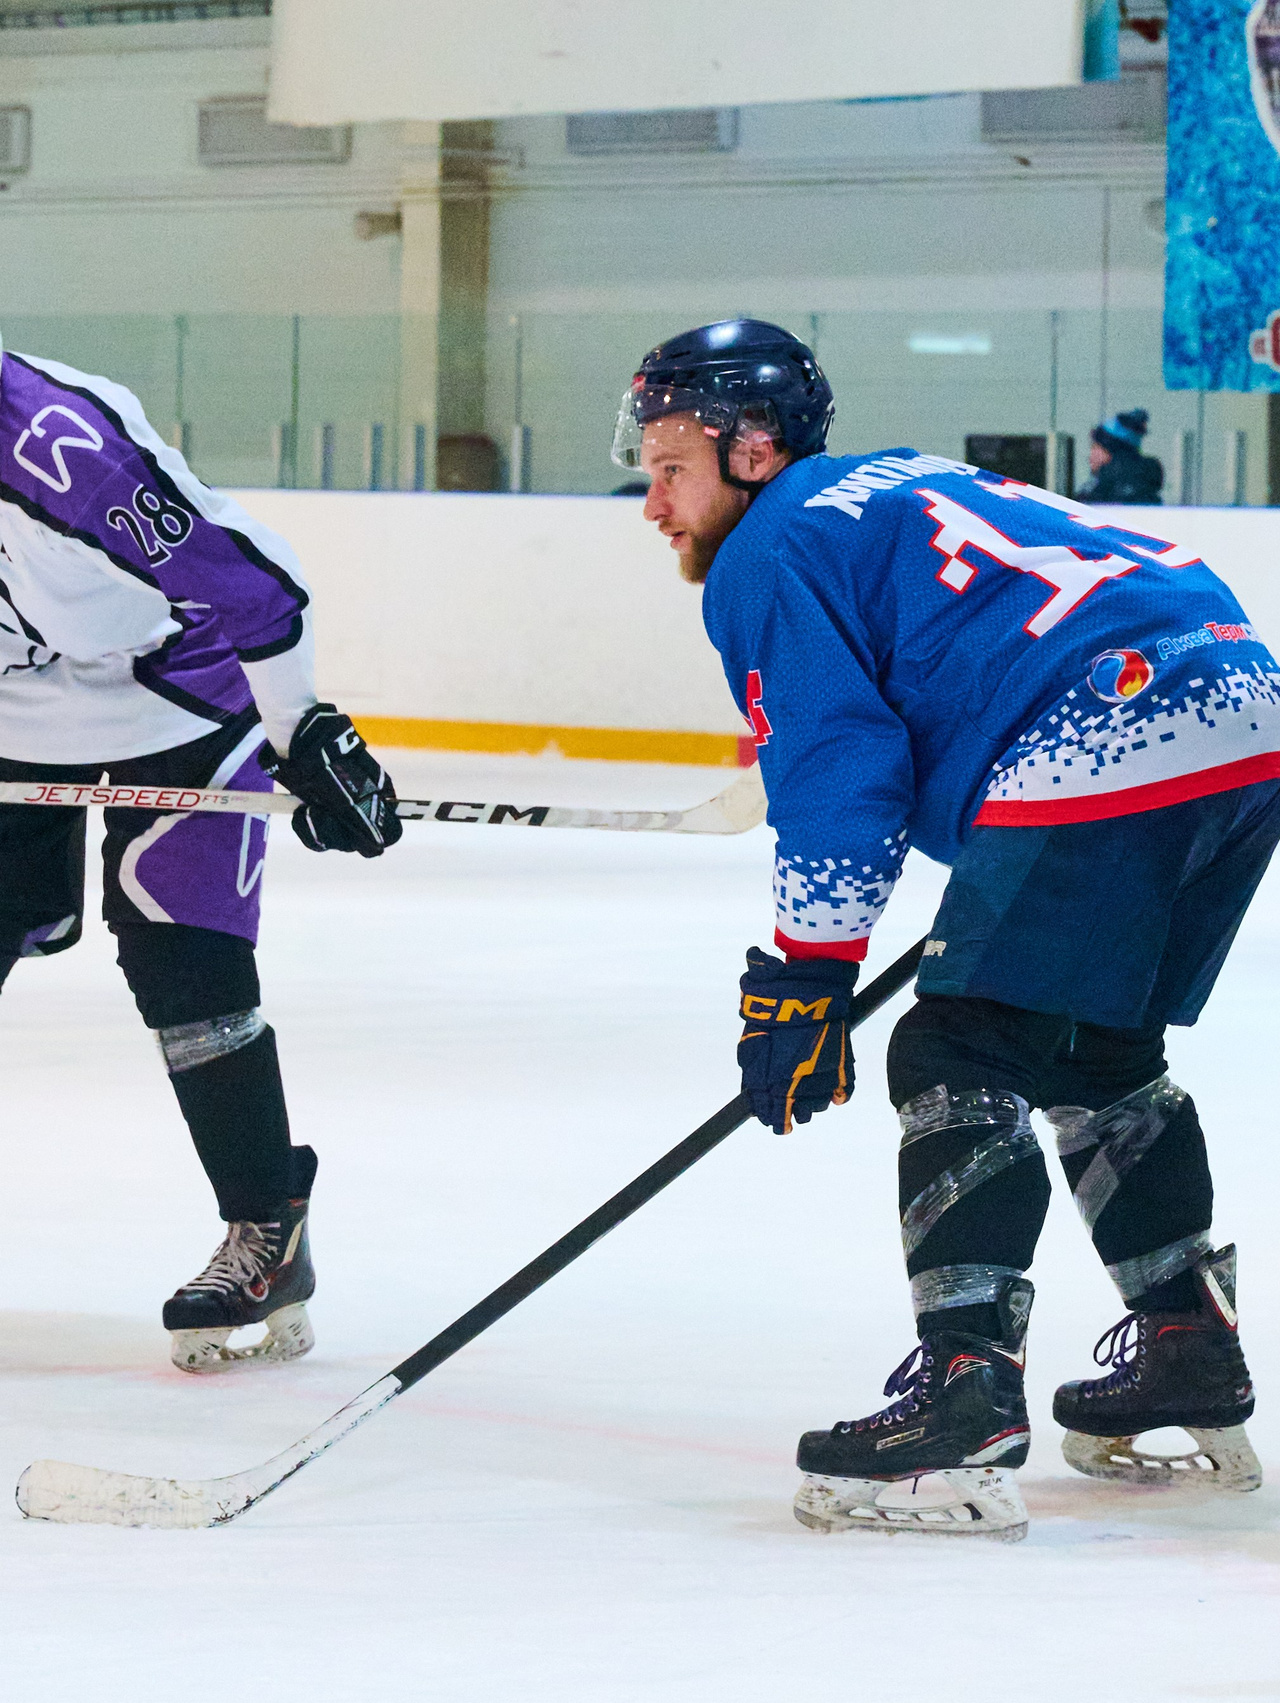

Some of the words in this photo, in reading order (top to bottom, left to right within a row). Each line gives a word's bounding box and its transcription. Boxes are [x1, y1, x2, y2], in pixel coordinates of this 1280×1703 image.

[106, 483, 194, 568] 28
[23, 785, 201, 809] JETSPEED
[741, 994, 833, 1023] CM
